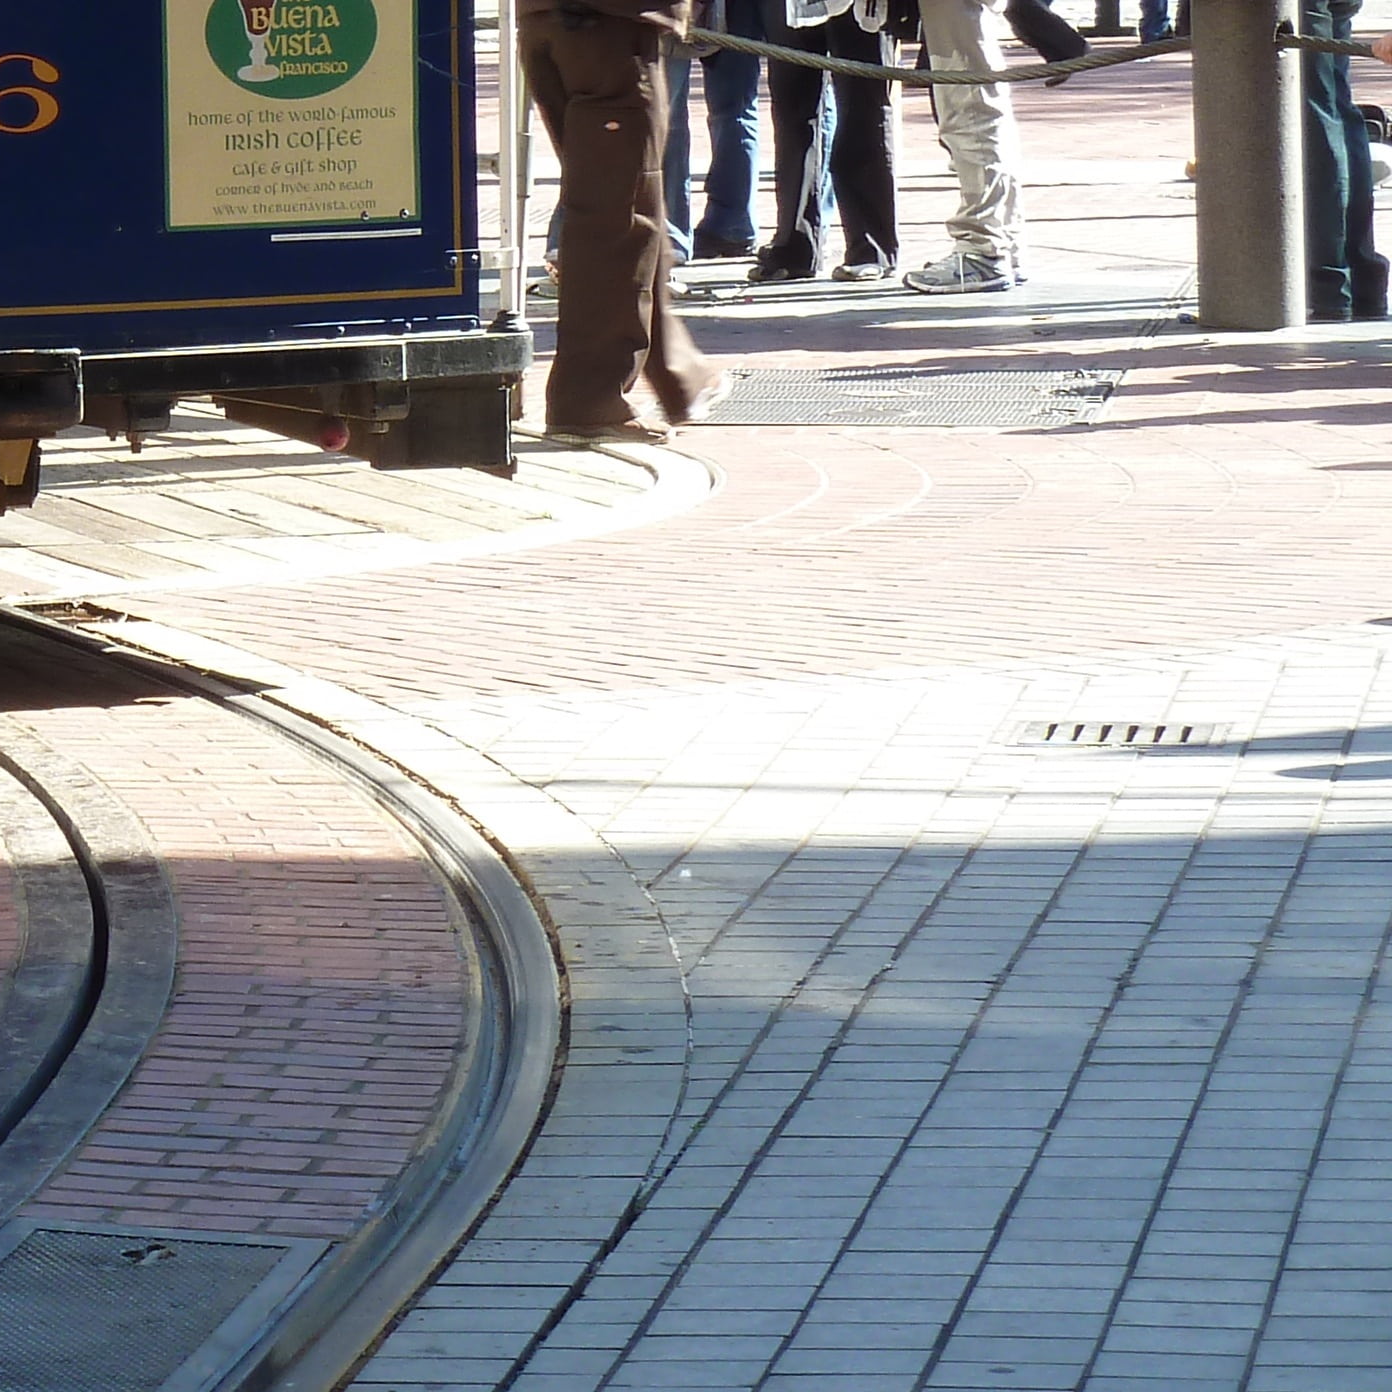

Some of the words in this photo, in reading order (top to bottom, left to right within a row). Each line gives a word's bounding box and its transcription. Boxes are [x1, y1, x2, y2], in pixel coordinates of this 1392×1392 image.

[187, 111, 232, 127] home
[236, 109, 254, 127] of
[258, 109, 284, 124] the
[271, 160, 280, 175] &
[319, 157, 358, 175] shop
